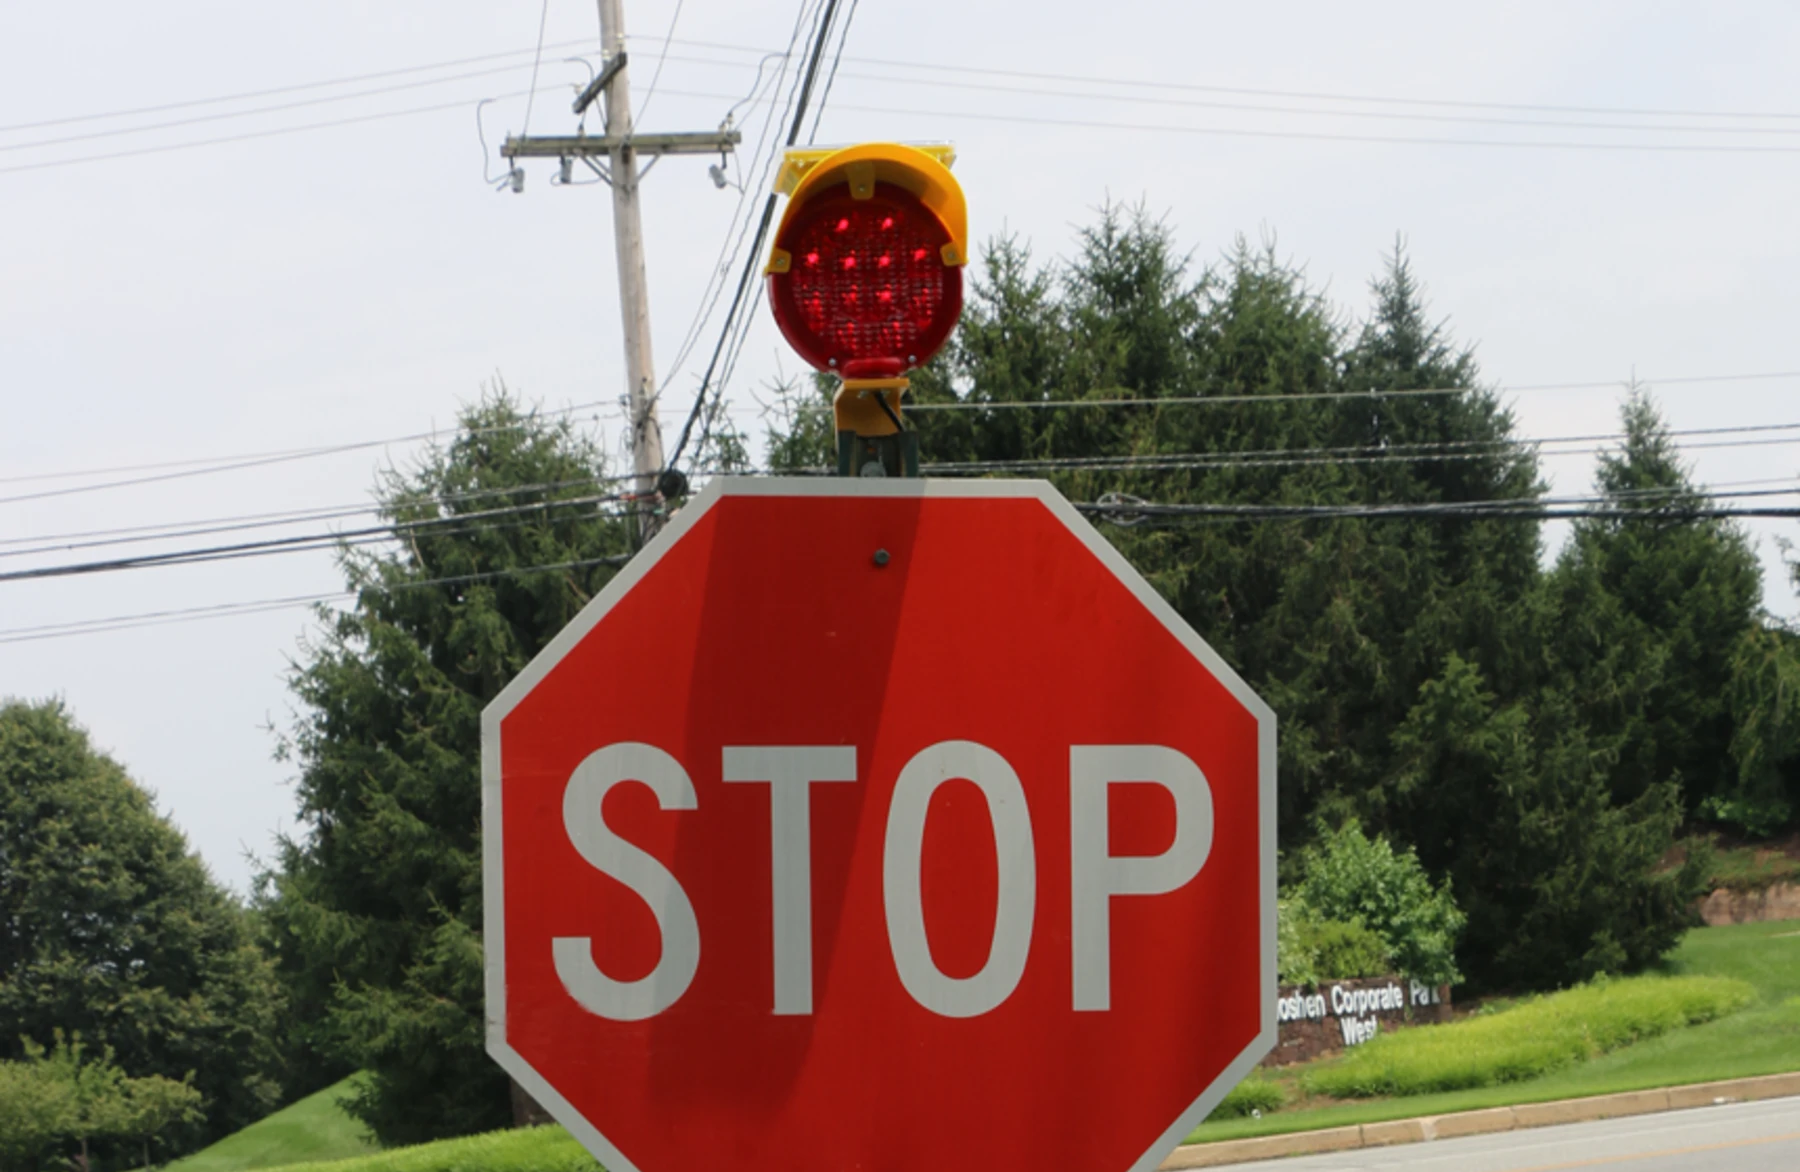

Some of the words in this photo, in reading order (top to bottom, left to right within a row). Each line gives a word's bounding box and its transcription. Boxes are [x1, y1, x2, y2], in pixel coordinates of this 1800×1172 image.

[552, 740, 1214, 1021] STOP
[1277, 988, 1326, 1021] oshen
[1331, 982, 1403, 1018] Corporate
[1340, 1014, 1378, 1046] West
